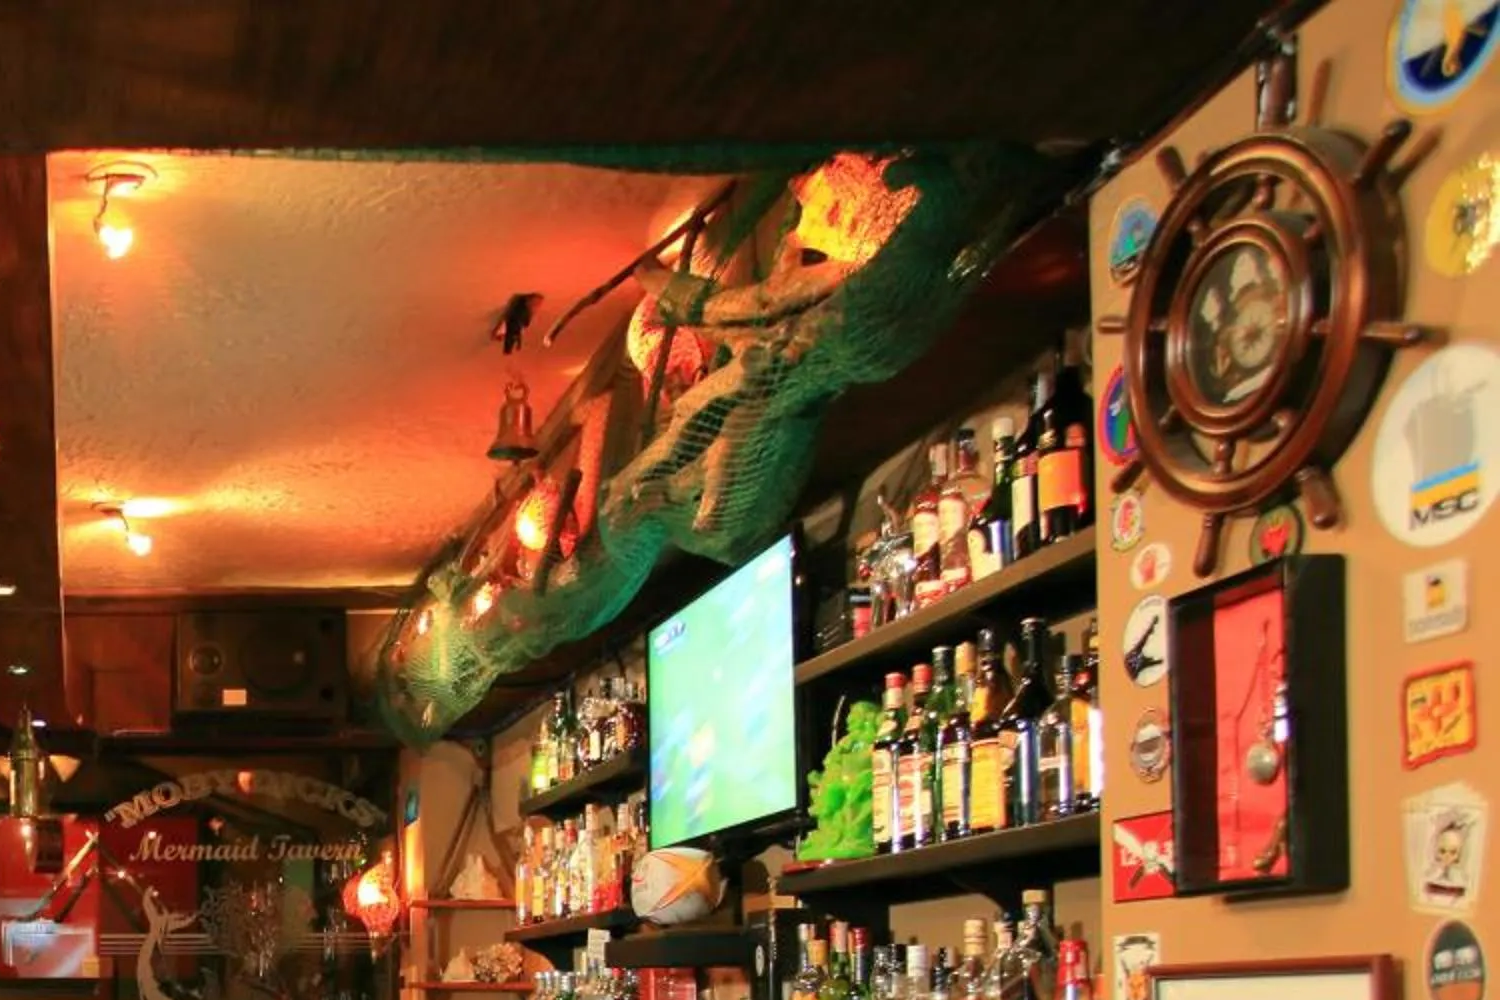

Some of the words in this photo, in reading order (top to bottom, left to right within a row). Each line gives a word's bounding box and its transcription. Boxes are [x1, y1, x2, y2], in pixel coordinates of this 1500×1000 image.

[1409, 487, 1479, 531] MSC
[130, 833, 257, 862] Mermaid
[267, 833, 362, 860] Tavern
